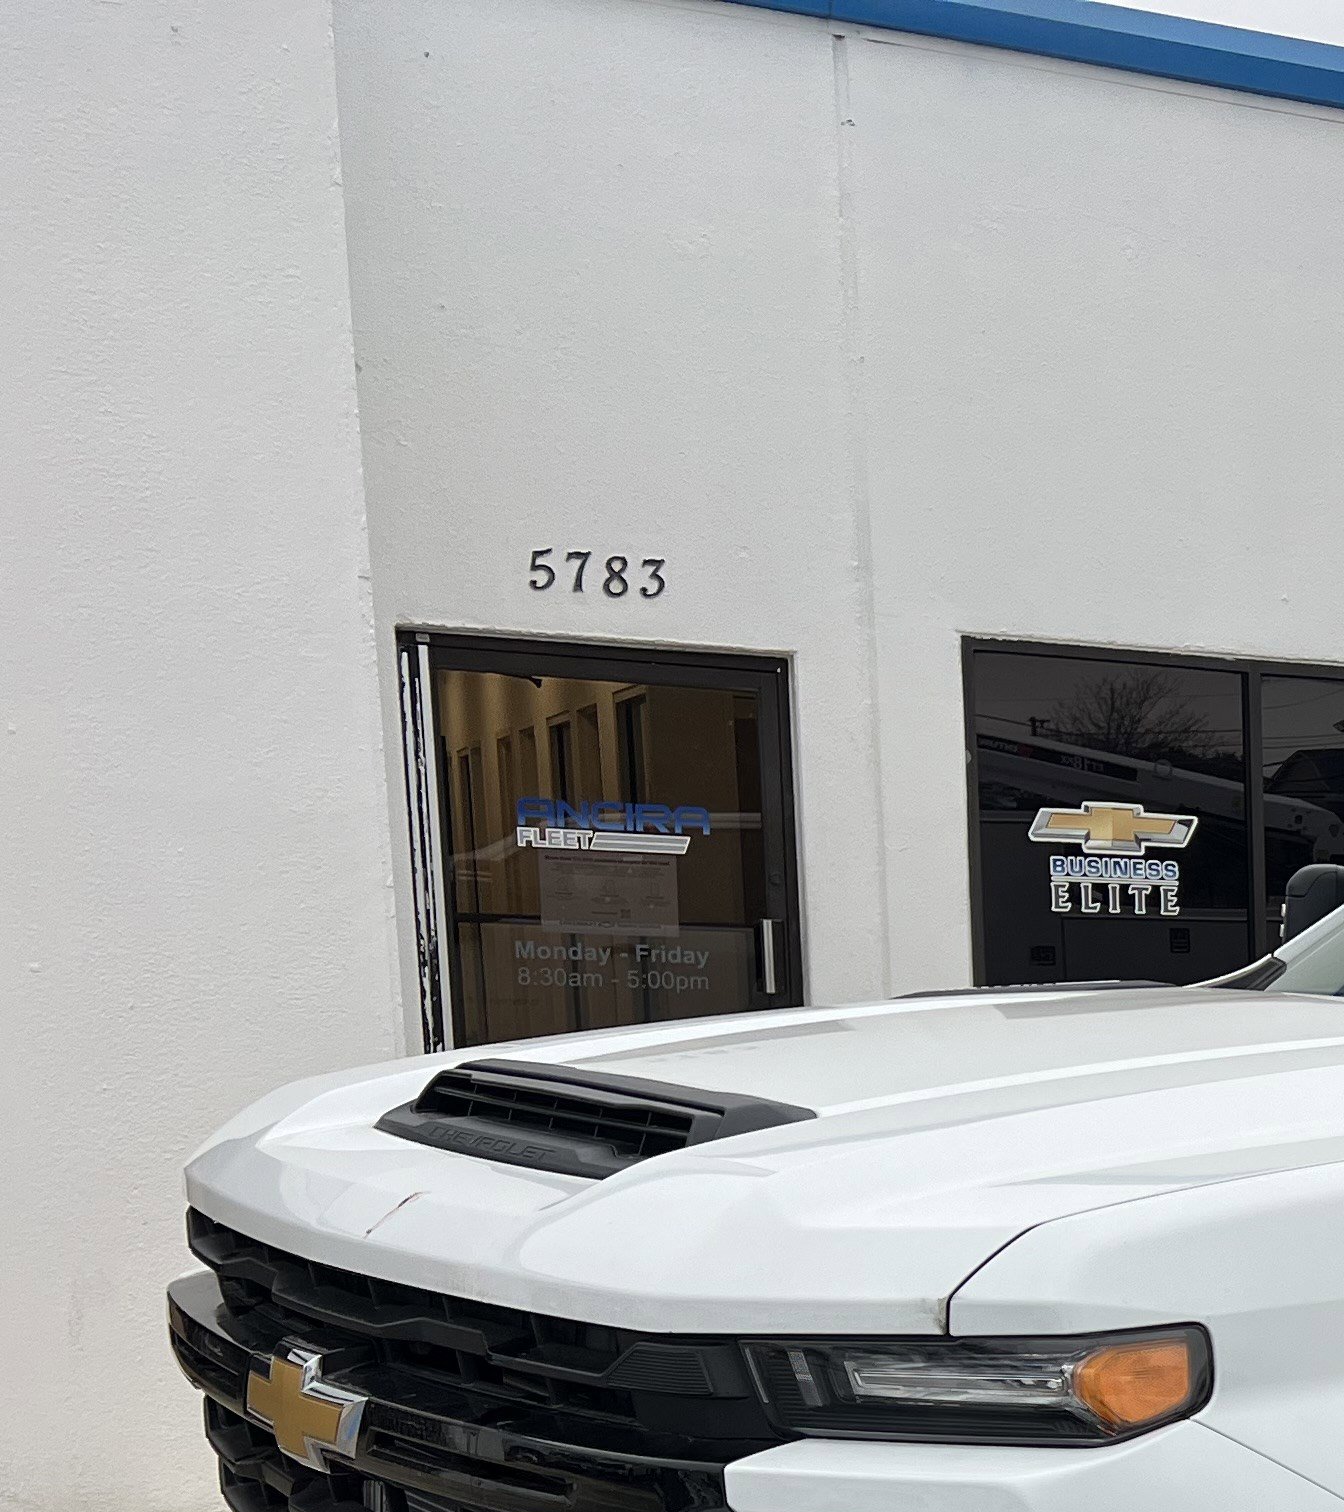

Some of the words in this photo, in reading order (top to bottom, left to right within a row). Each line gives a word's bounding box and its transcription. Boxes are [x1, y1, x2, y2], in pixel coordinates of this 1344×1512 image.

[529, 547, 665, 599] 5783
[516, 796, 711, 835] ANCIRA
[516, 826, 593, 850] FLEET
[1050, 855, 1179, 880] BUSINESS
[1051, 881, 1180, 915] ELITE
[515, 940, 612, 966] Monday
[635, 944, 710, 969] Friday
[517, 967, 604, 988] 8:30am
[627, 970, 710, 994] 5:00pm
